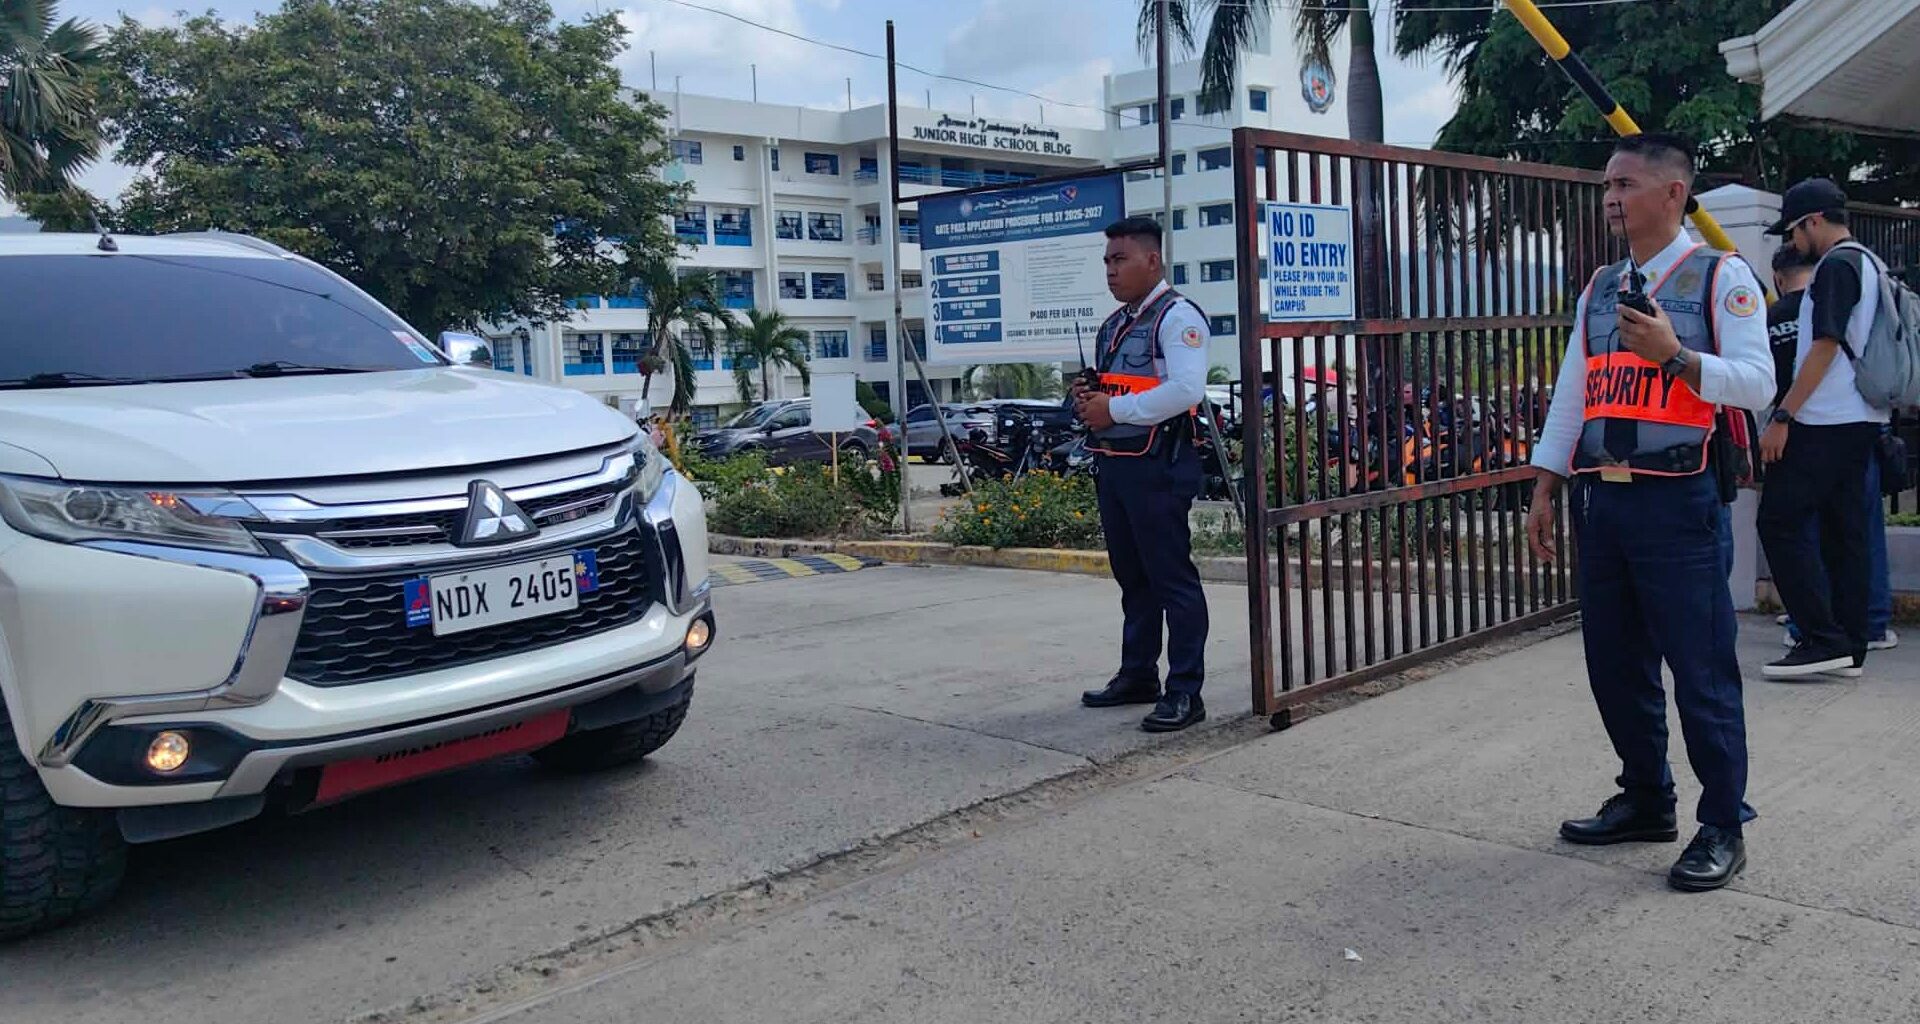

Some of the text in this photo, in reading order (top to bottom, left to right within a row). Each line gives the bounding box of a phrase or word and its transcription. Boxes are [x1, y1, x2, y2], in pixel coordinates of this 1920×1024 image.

[913, 126, 1071, 154] JUNIOR HIGH SCHOOL BLDG
[935, 223, 950, 235] GATE
[950, 222, 966, 234] PASS
[966, 218, 1005, 232] APPLICATION
[1005, 214, 1040, 228] PROCEDURE
[1041, 212, 1054, 224] FOR
[1272, 212, 1314, 237] NO ID
[1274, 242, 1346, 267] NO ENTRY
[930, 256, 936, 275] 1
[1274, 270, 1348, 282] PLEASE PIN YOUR IDs
[931, 280, 938, 298] 2
[1274, 286, 1340, 296] WHILE INSIDE THIS
[932, 303, 940, 320] 3
[1049, 309, 1060, 318] PER
[1062, 308, 1076, 318] GATE
[1078, 307, 1094, 317] PASS
[1274, 300, 1306, 312] CAMPUS
[934, 325, 941, 343] 4
[1585, 366, 1676, 409] SECURITY
[436, 568, 573, 622] NDX 2405
